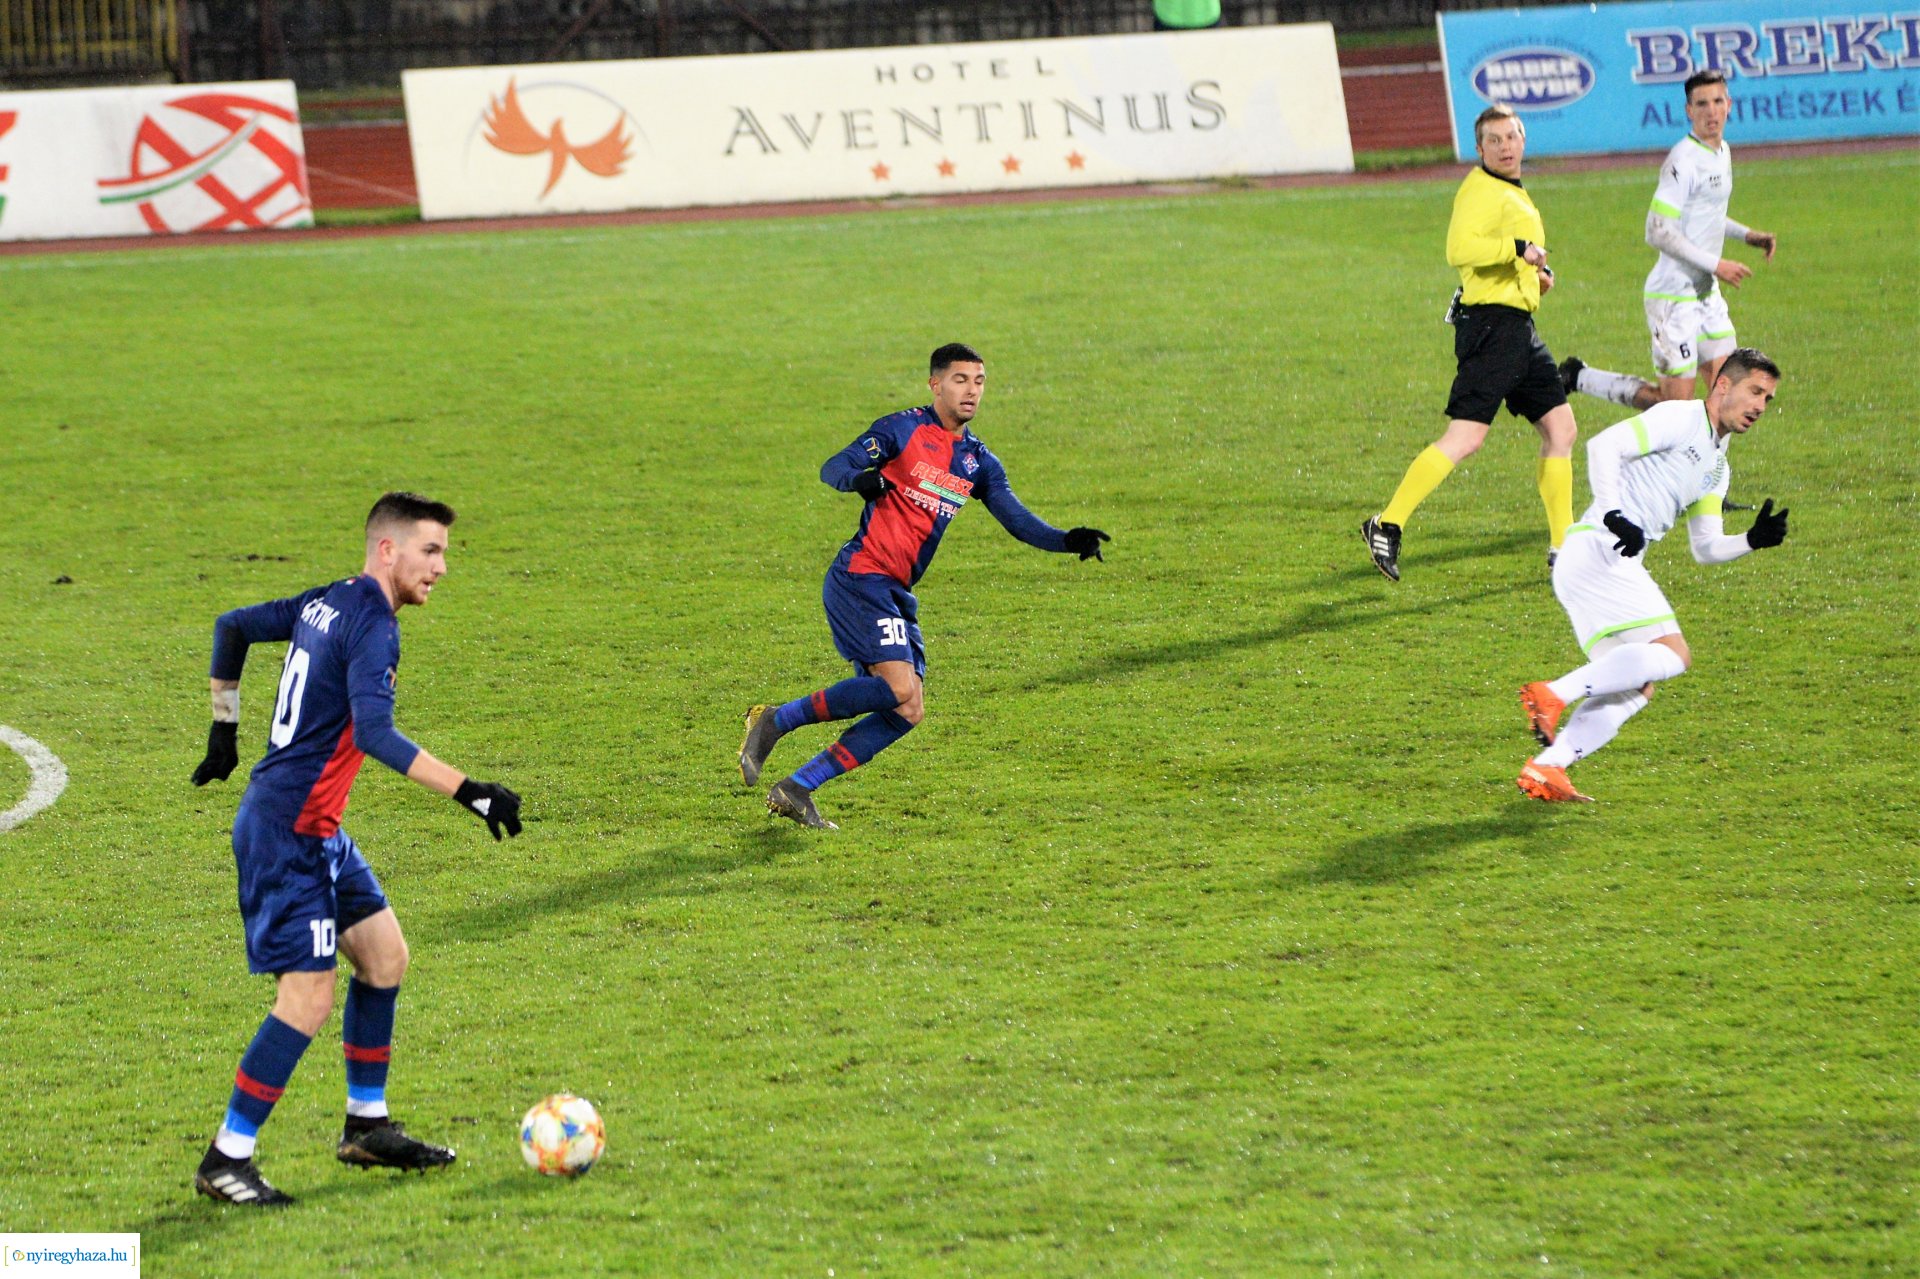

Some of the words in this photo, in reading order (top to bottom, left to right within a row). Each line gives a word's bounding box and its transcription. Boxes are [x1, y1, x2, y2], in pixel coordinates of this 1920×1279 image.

[876, 57, 1057, 84] HOTEL
[722, 80, 1229, 157] AVENTINUS
[1641, 88, 1886, 129] ALTRÉSZEK
[1679, 343, 1691, 360] 6
[877, 618, 908, 645] 30
[310, 918, 336, 958] 10
